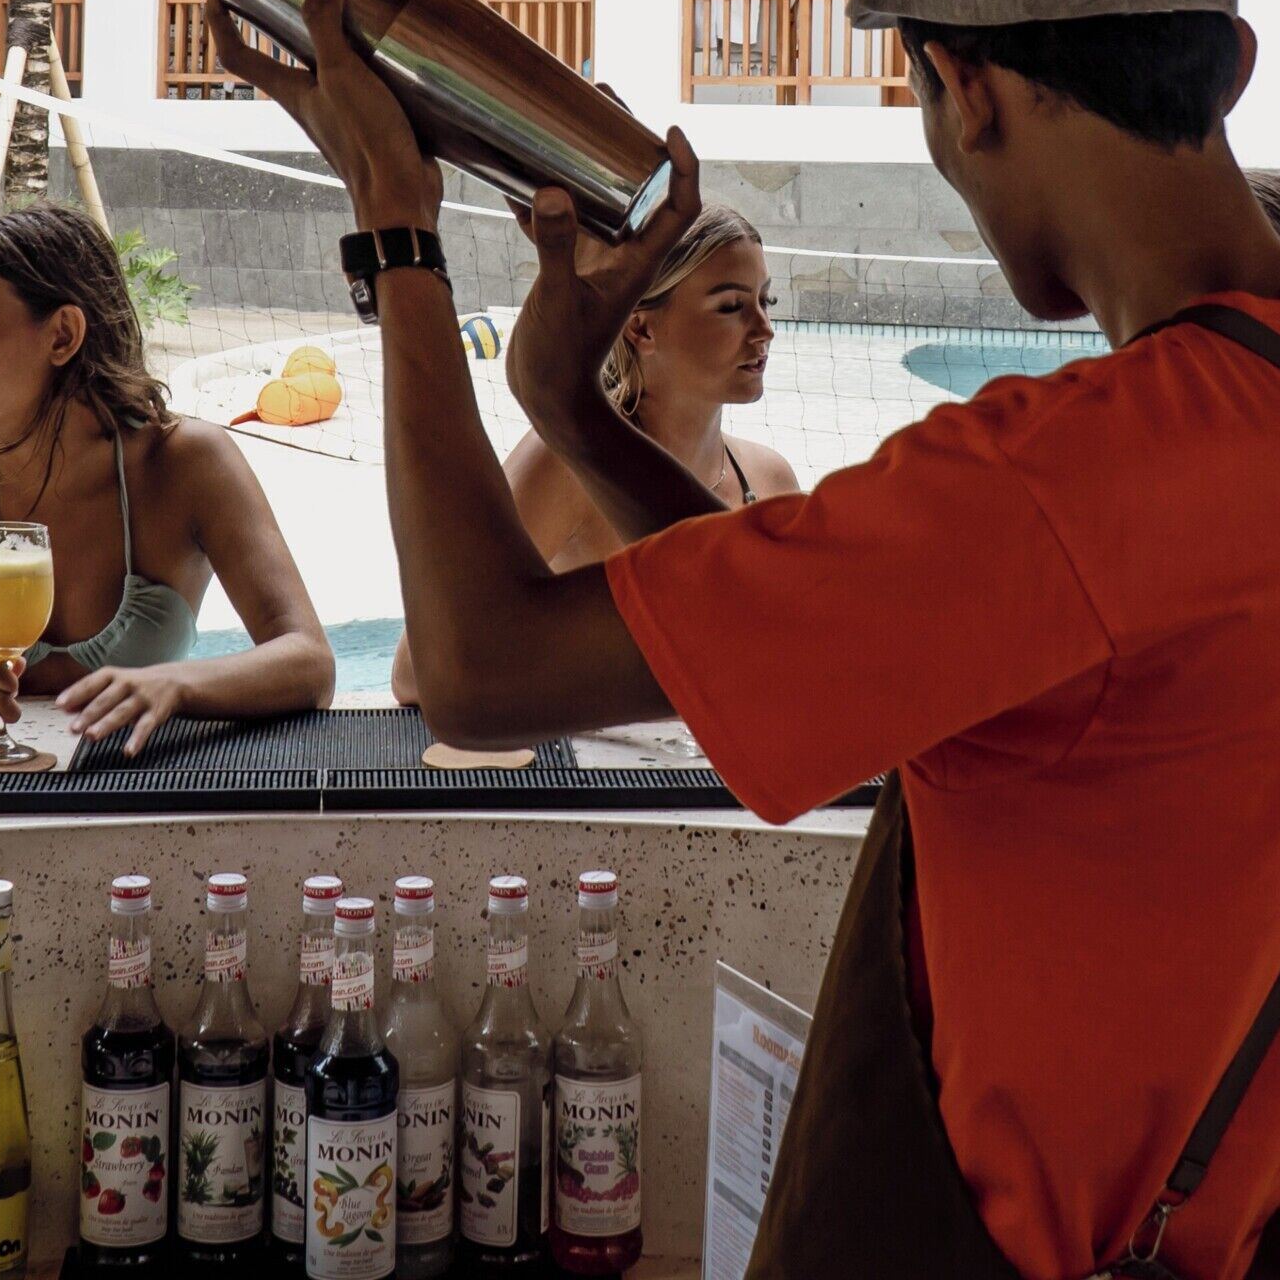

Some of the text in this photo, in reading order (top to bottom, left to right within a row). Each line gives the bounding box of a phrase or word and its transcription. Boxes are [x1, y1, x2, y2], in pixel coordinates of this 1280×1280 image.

[585, 881, 617, 891] MONIN
[340, 907, 373, 917] MONIN
[85, 1107, 160, 1129] MONIN
[186, 1104, 262, 1126] MONIN
[466, 1107, 502, 1130] NIN
[562, 1100, 636, 1122] MONIN
[317, 1137, 393, 1163] MONIN
[577, 1149, 616, 1163] Bubble
[91, 1154, 146, 1175] Strawberry
[583, 1162, 610, 1176] Gum
[340, 1196, 361, 1210] Blue
[342, 1209, 373, 1226] Lagoon
